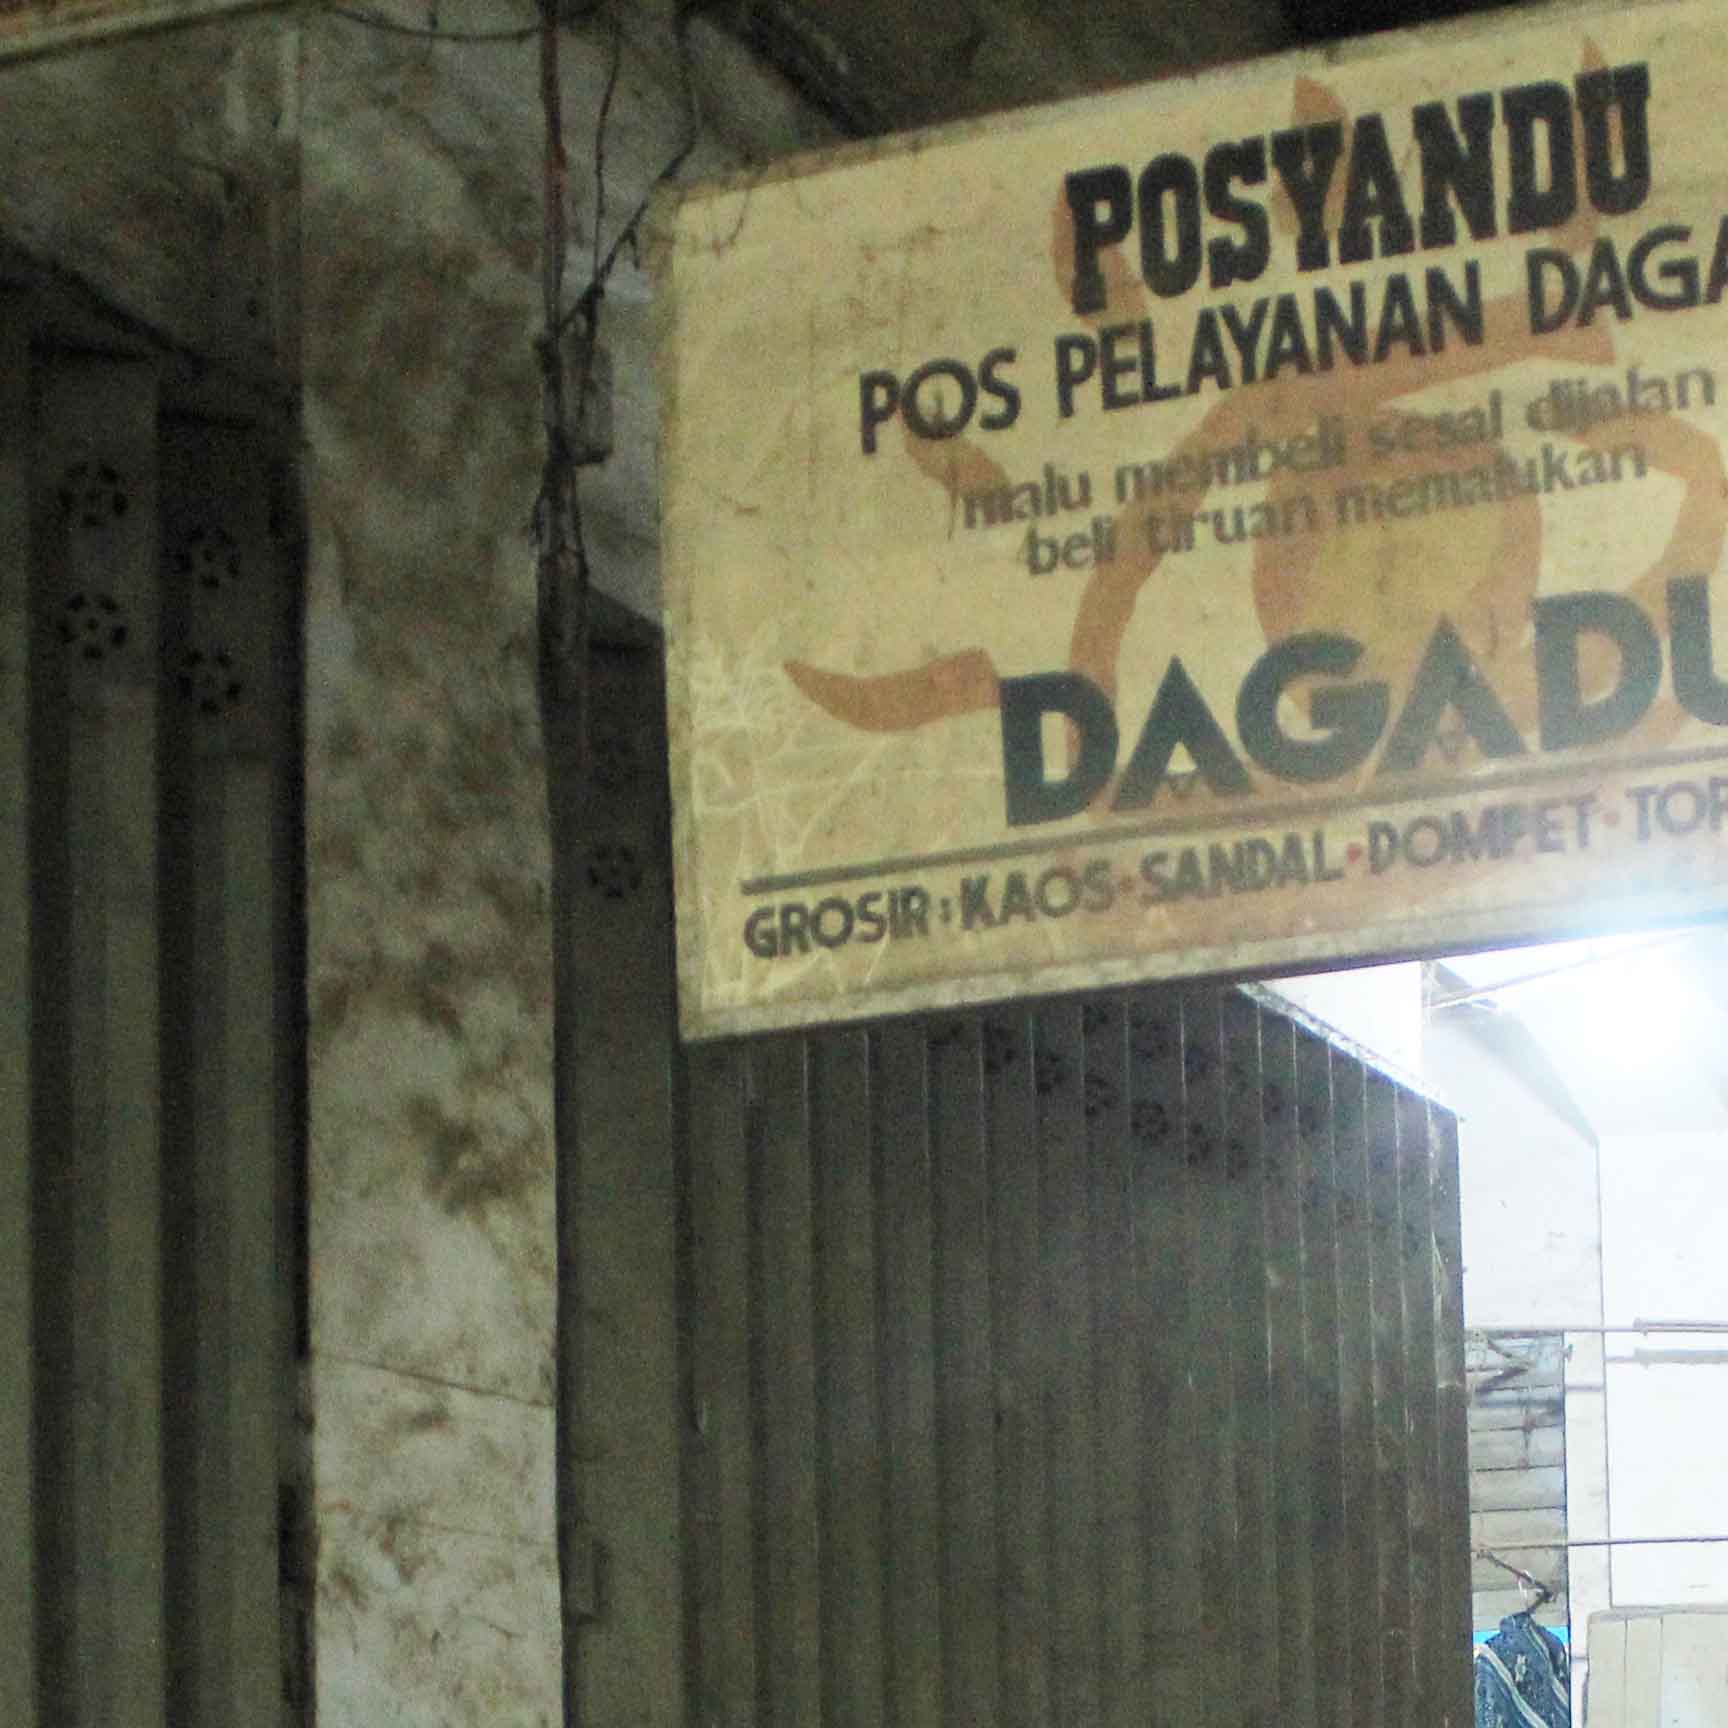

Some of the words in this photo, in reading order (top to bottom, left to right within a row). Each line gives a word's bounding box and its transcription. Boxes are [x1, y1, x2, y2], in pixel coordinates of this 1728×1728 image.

[1064, 62, 1653, 315] POSYANDU
[859, 345, 1020, 454] POS
[1054, 257, 1485, 419] PELAYANAN
[963, 461, 1093, 531] malu
[1115, 412, 1347, 505] membeli
[1369, 388, 1503, 452] sesal
[1026, 511, 1116, 577] beli
[1149, 492, 1318, 556] tiruan
[1336, 440, 1648, 528] memalukan
